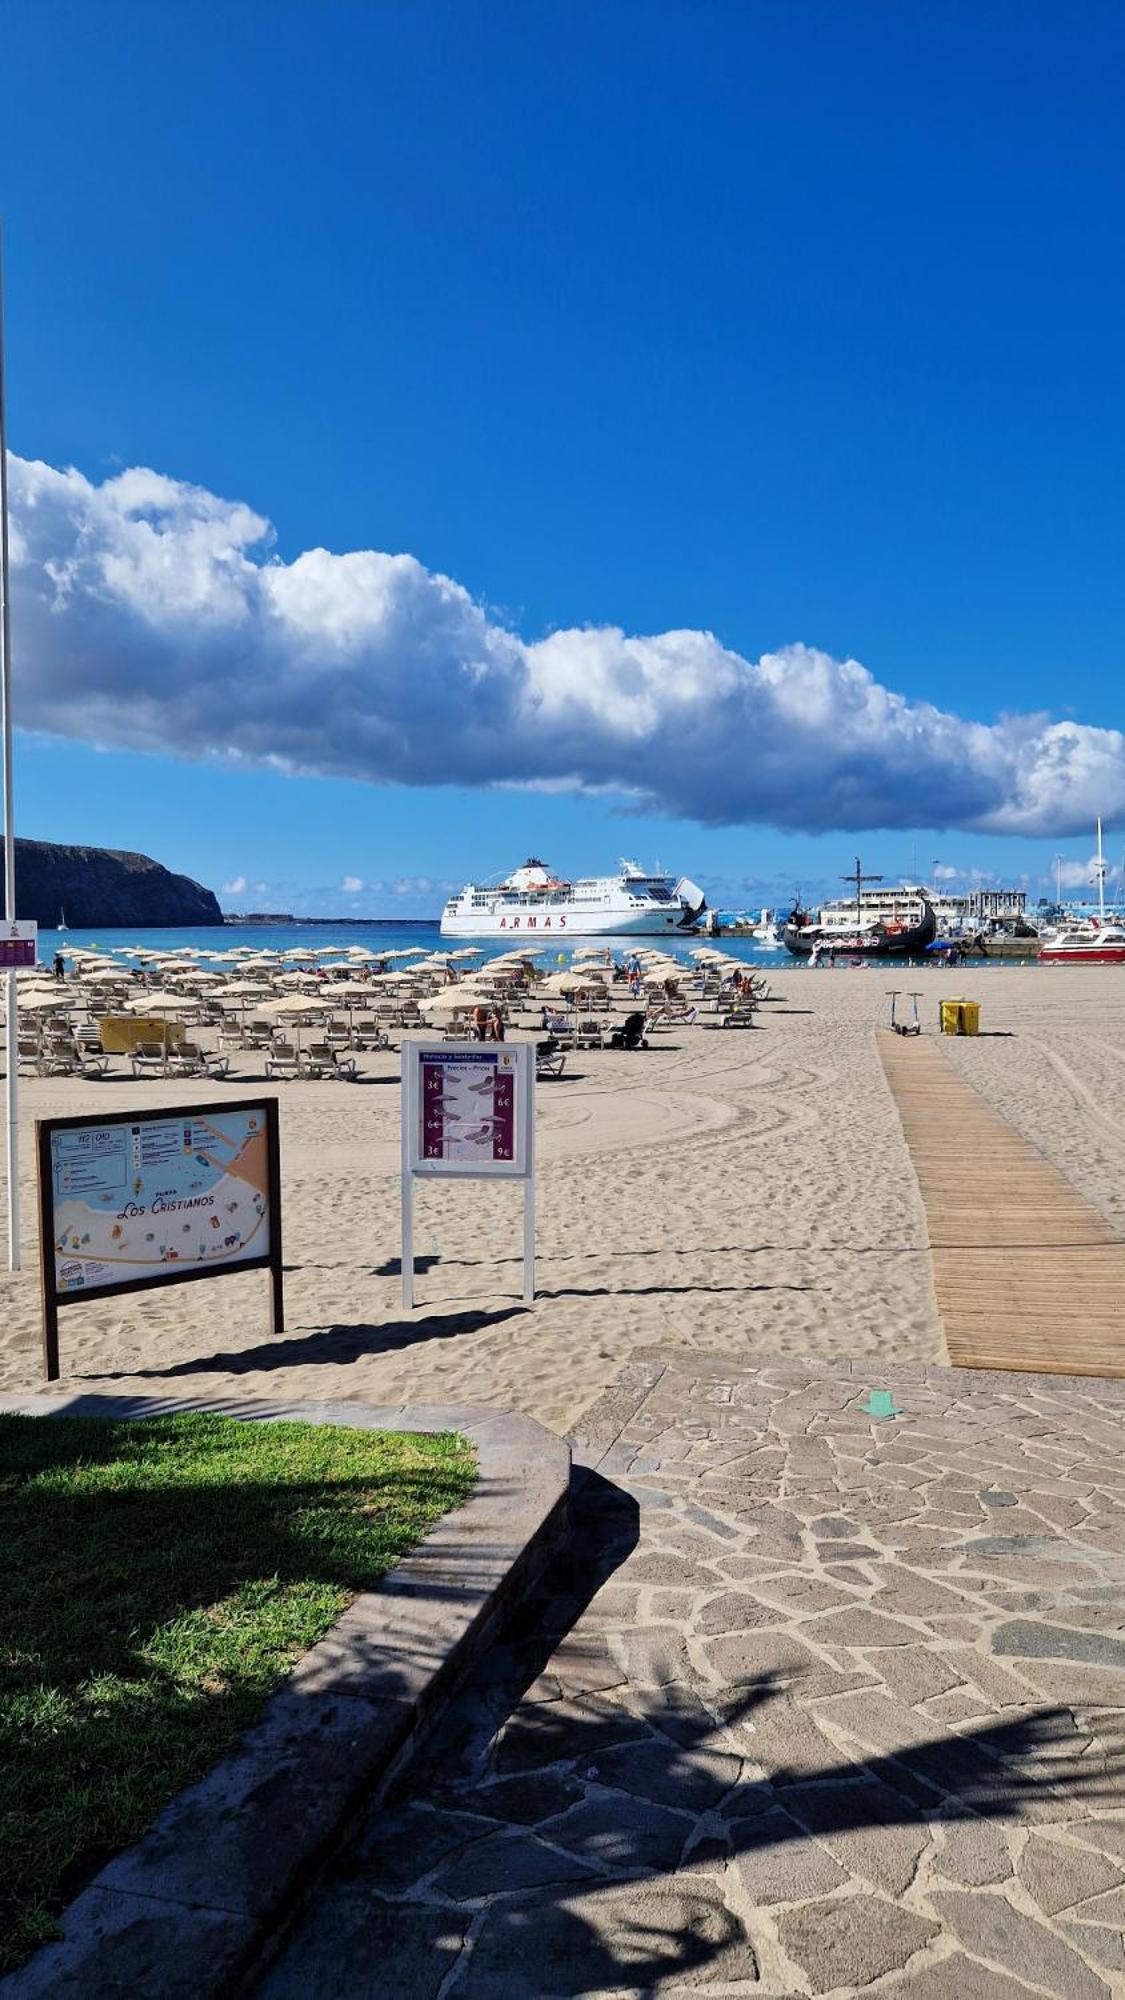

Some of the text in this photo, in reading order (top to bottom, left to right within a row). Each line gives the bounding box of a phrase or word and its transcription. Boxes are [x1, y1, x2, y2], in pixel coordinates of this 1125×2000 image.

[499, 915, 567, 928] ARMAS
[427, 1081, 439, 1090] 3€
[498, 1099, 510, 1107] 6€
[427, 1121, 439, 1129] 6€
[427, 1146, 439, 1156] 3€
[497, 1147, 510, 1156] 9€
